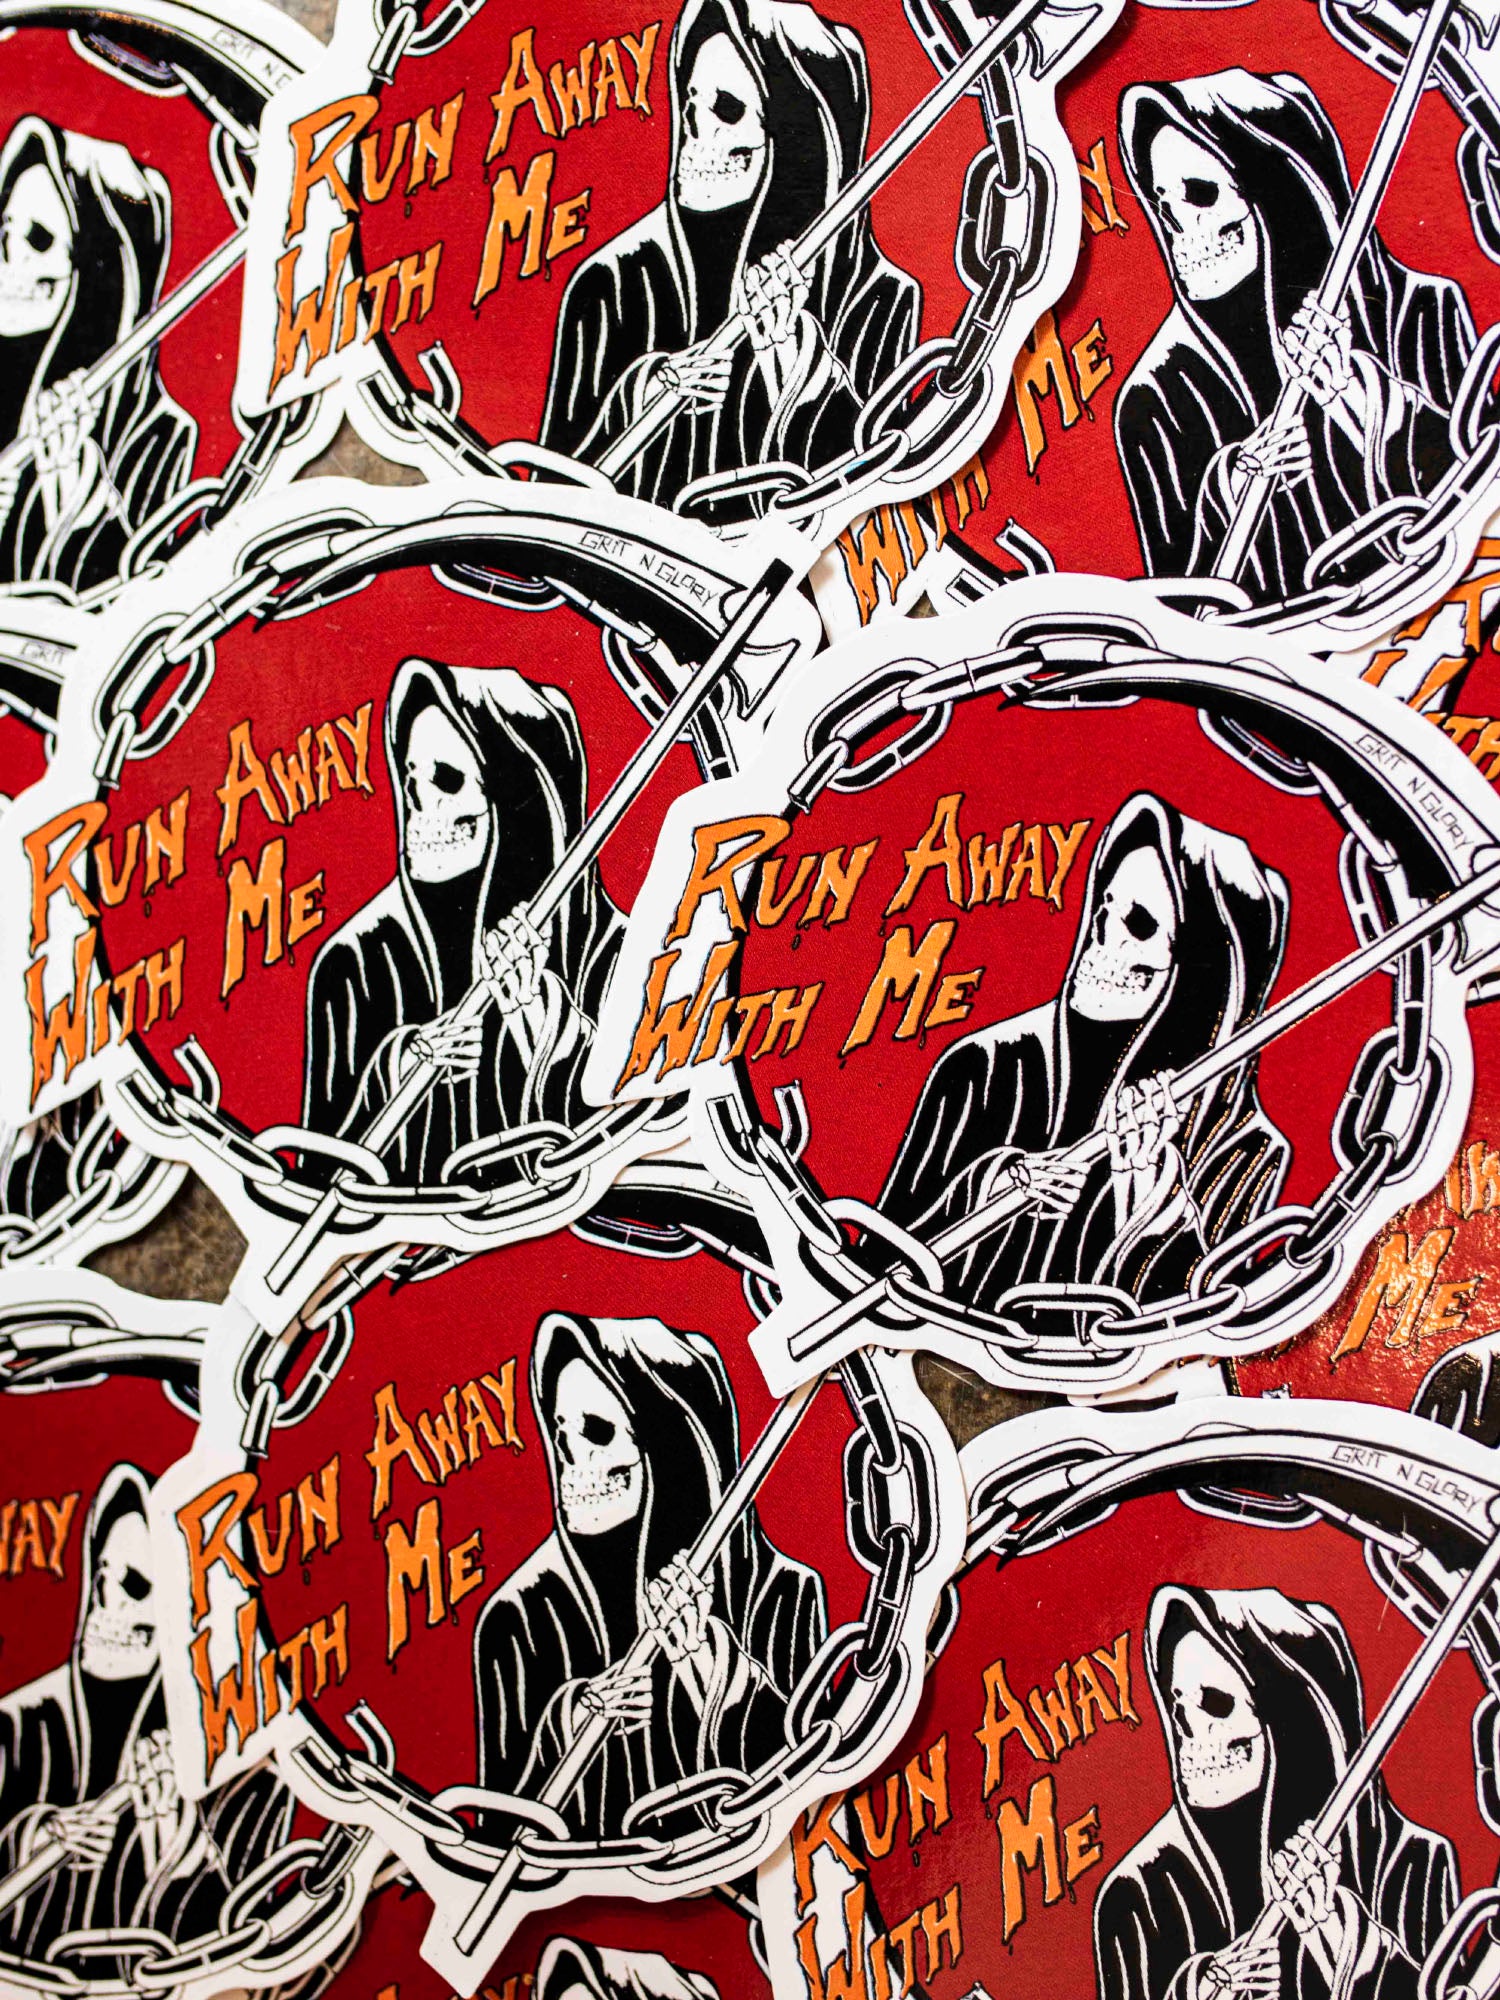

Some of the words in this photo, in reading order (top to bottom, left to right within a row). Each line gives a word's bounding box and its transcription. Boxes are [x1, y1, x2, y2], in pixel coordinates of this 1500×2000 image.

[285, 91, 465, 245] RUN
[483, 20, 662, 166] AWAY
[268, 220, 443, 399] WITH
[473, 150, 592, 308] ME
[578, 531, 632, 557] GRIT
[639, 553, 656, 571] N
[654, 561, 719, 607] GLORY
[22, 788, 192, 955] RUN
[213, 700, 376, 858] AWAY
[663, 814, 880, 948] RUN
[883, 792, 1091, 914] AWAY
[1354, 733, 1408, 771] GRIT
[1407, 776, 1427, 794] N
[1418, 791, 1475, 850] GLORY
[23, 921, 188, 1108] WITH
[220, 836, 326, 1000] ME
[613, 936, 824, 1093] WITH
[839, 917, 984, 1060] ME
[175, 1470, 341, 1629] RUN
[362, 1357, 526, 1524] AWAY
[1332, 1444, 1388, 1469] GRIT
[1397, 1463, 1414, 1481] N
[1414, 1470, 1480, 1513] GLORY
[187, 1596, 349, 1785] WITH
[382, 1497, 488, 1668] ME
[970, 1630, 1142, 1802] AWAY
[996, 1774, 1105, 1950] ME
